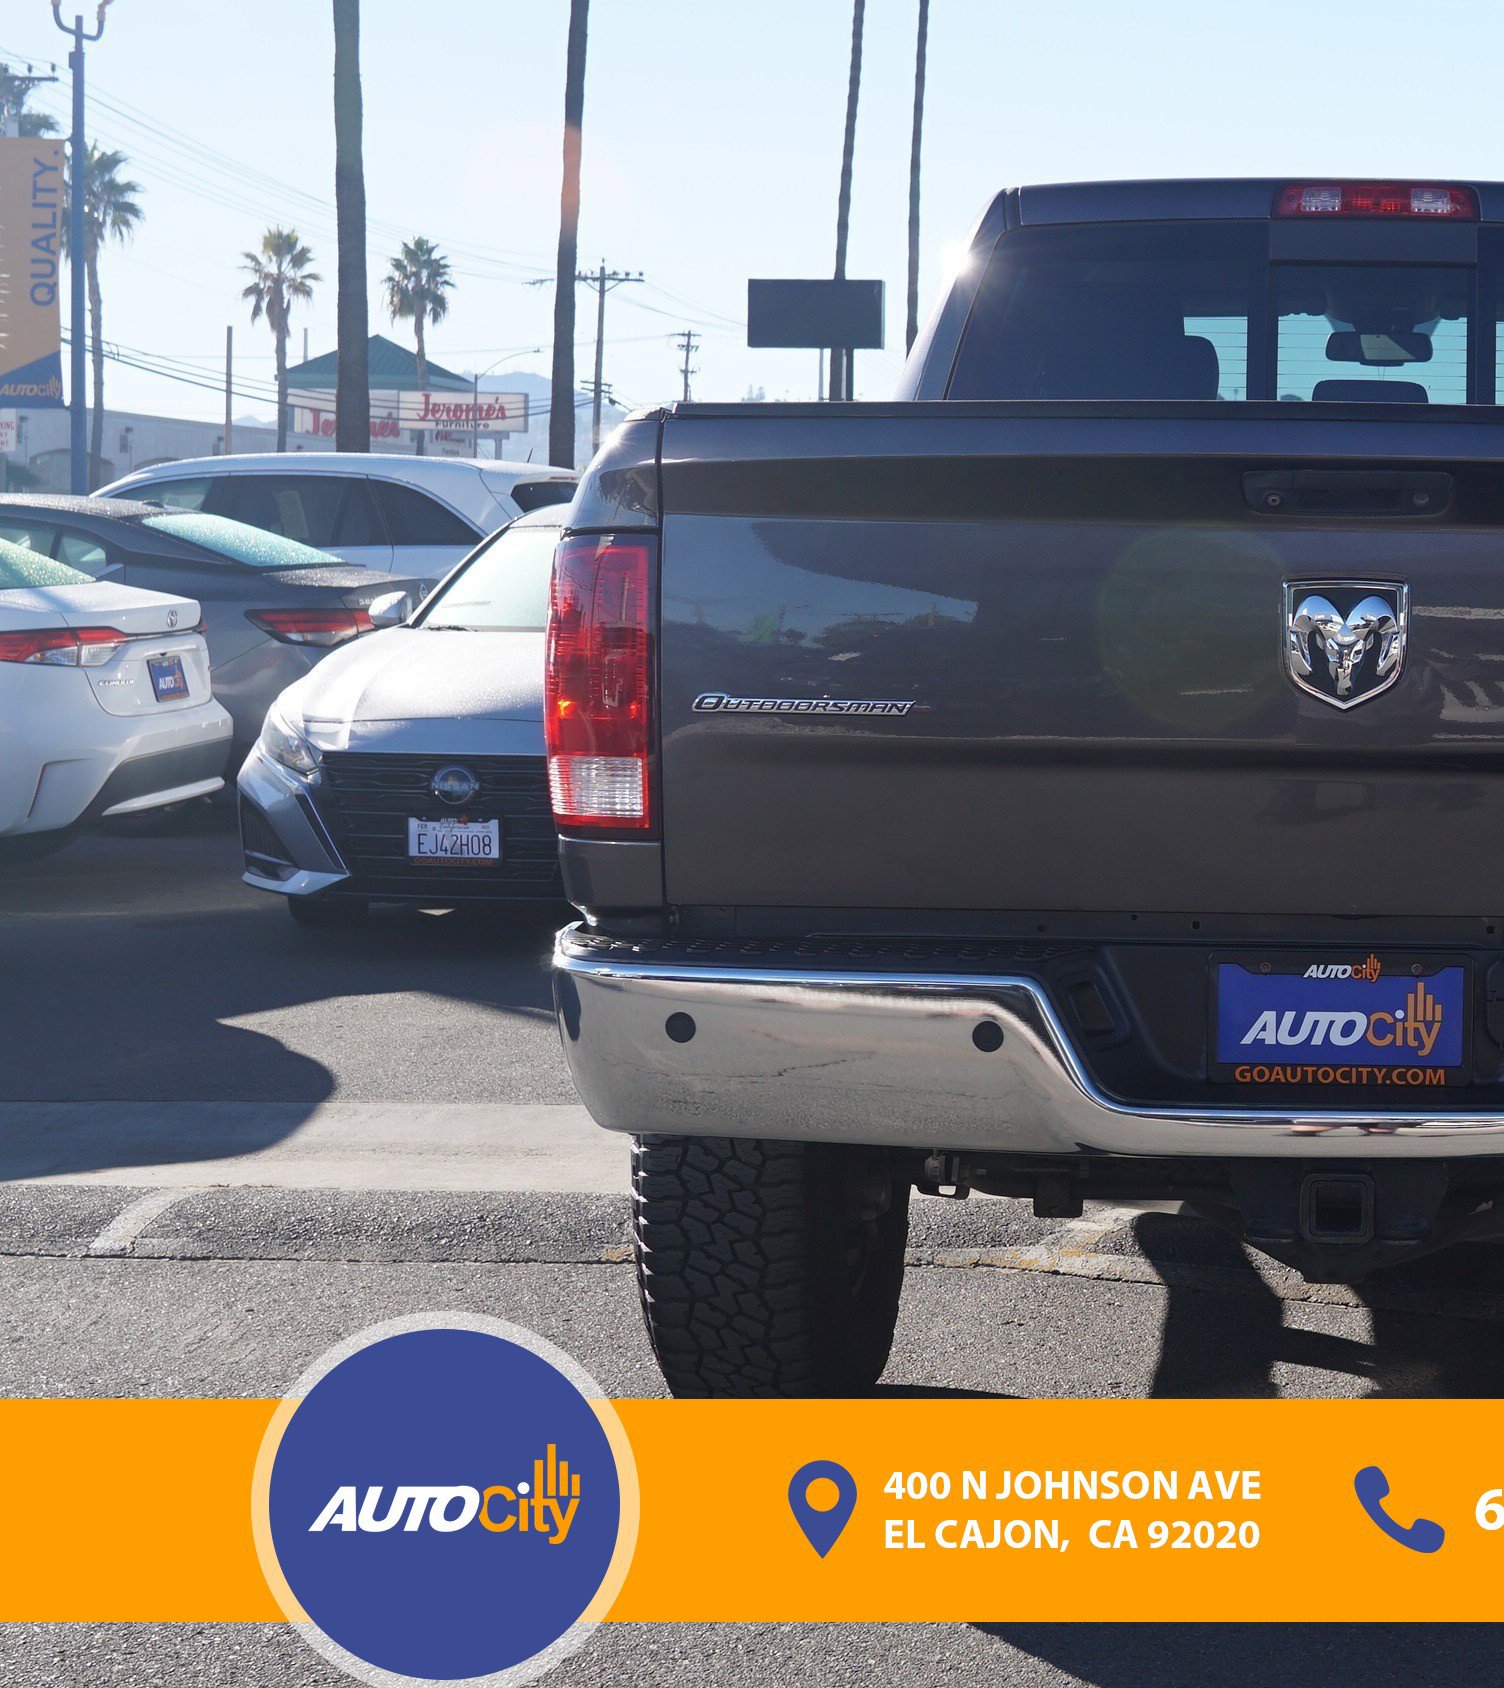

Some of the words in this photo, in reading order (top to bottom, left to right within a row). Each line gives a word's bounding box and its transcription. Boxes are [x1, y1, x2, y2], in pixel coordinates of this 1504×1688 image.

[30, 149, 59, 307] QUALITY.
[417, 392, 507, 420] Jerome's
[431, 781, 480, 791] NISSAN
[417, 833, 492, 856] EJ42H08
[1234, 1065, 1446, 1086] GOAUTOCITY.COM
